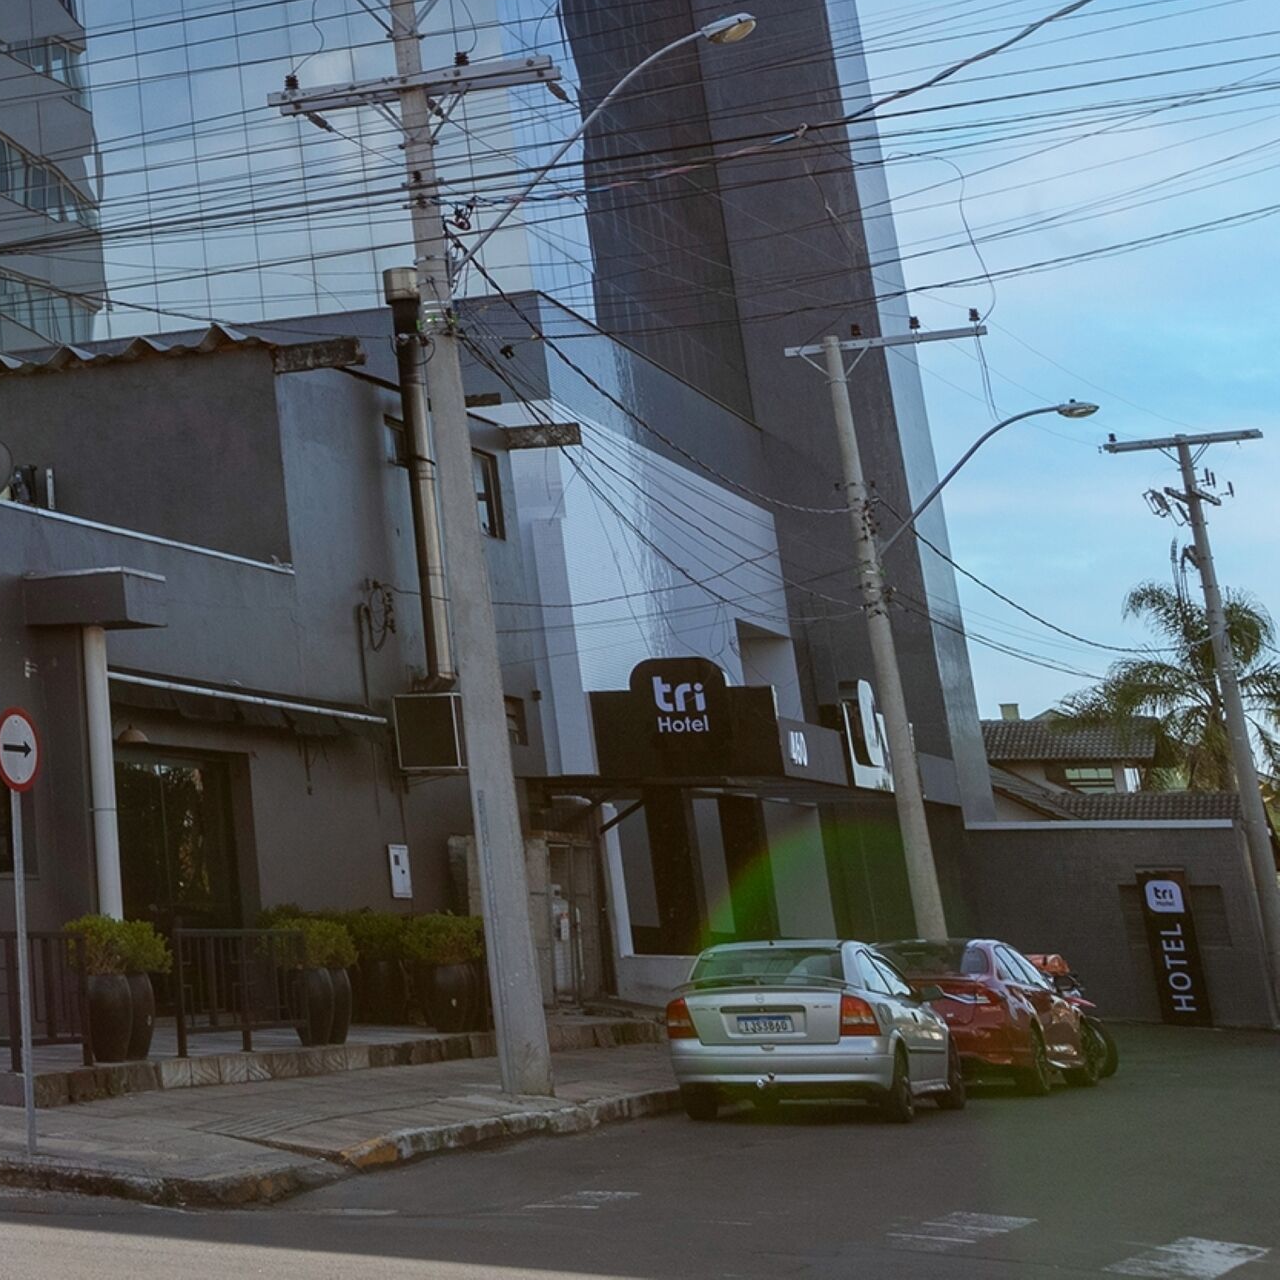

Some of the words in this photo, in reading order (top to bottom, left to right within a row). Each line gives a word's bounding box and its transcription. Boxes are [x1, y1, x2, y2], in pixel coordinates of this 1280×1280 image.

[652, 676, 707, 713] tri
[657, 715, 710, 733] Hotel
[1153, 886, 1173, 900] tri
[1160, 923, 1197, 1012] HOTEL
